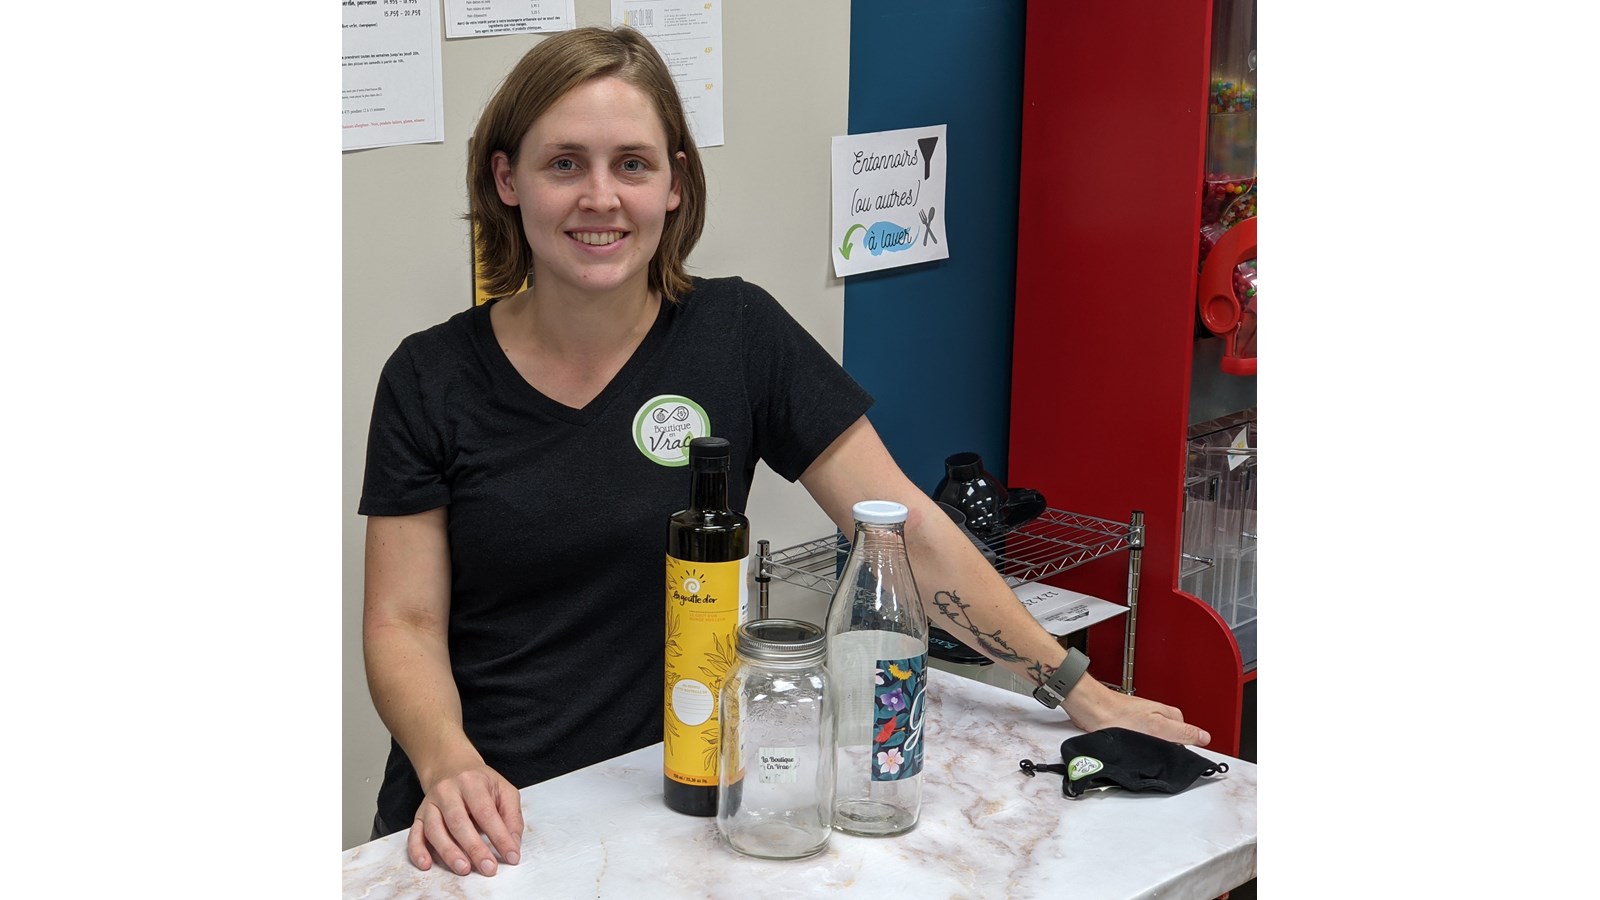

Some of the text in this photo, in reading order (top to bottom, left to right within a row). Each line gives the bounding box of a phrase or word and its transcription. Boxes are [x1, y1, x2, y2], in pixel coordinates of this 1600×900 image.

[853, 149, 918, 175] Entonnoirs
[851, 179, 920, 216] (ou autres)
[868, 226, 912, 251] à laver
[654, 422, 692, 433] Boutique
[649, 431, 690, 452] Vrac
[680, 594, 701, 606] goutte
[702, 593, 718, 604] d'or
[761, 756, 794, 764] La Boutique
